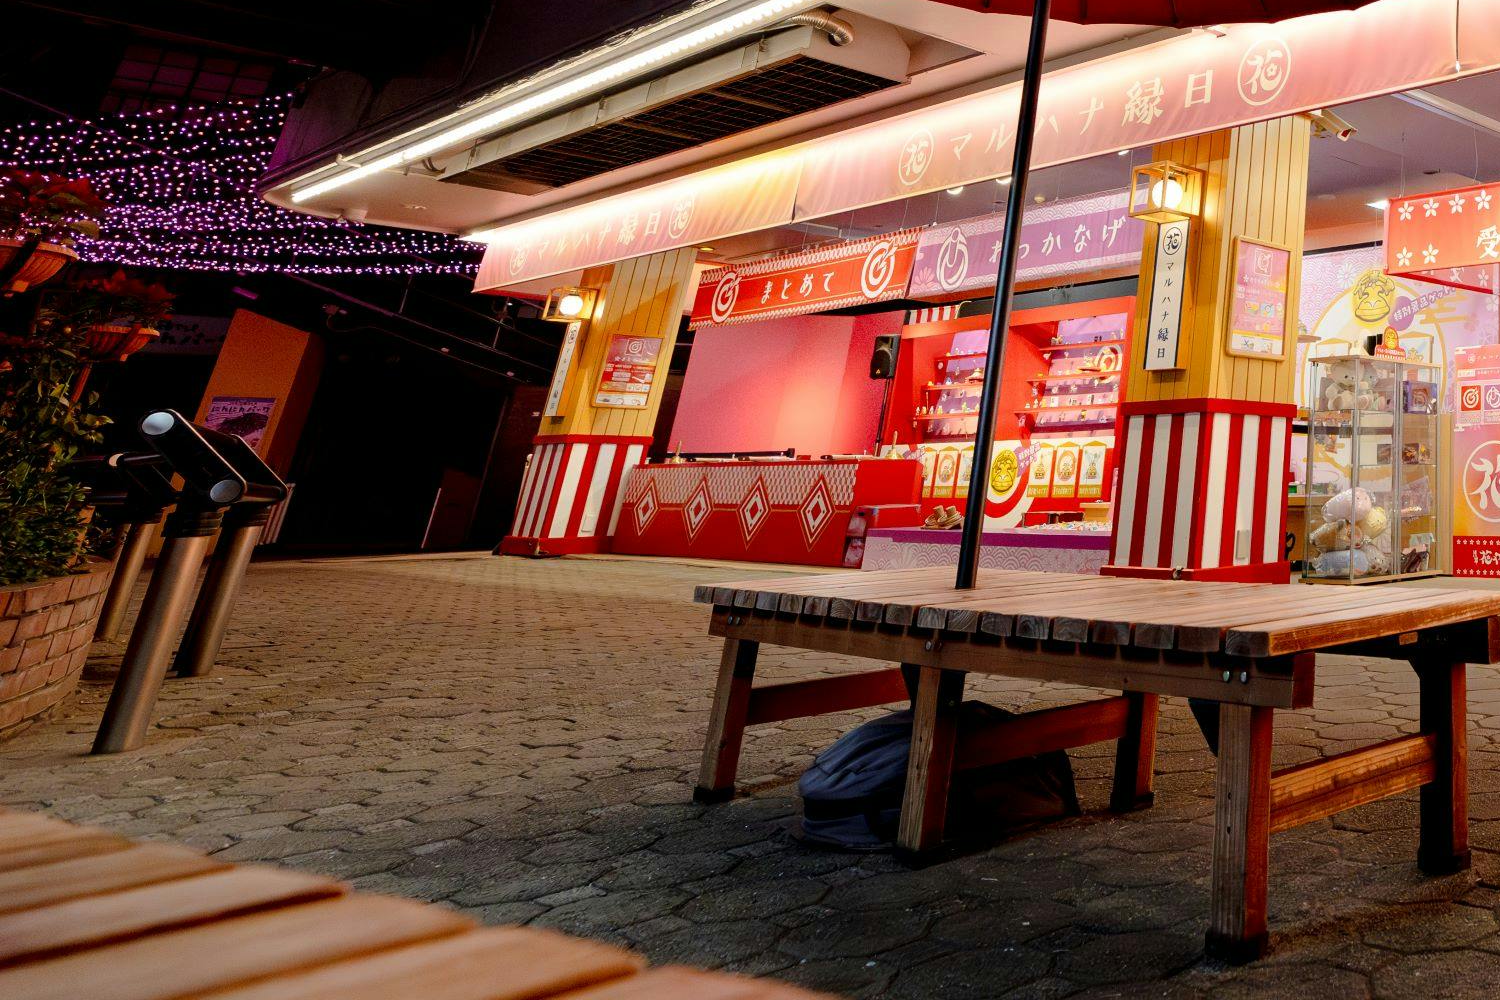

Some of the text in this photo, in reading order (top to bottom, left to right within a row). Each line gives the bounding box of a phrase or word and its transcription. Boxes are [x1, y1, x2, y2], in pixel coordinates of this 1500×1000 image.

[902, 138, 929, 177] 花
[1247, 50, 1284, 96] 花
[536, 210, 662, 260] マルハナ縁日
[671, 198, 692, 232] 花
[761, 271, 836, 304] まとあて
[1157, 233, 1180, 358] 花 マルハナ縁日
